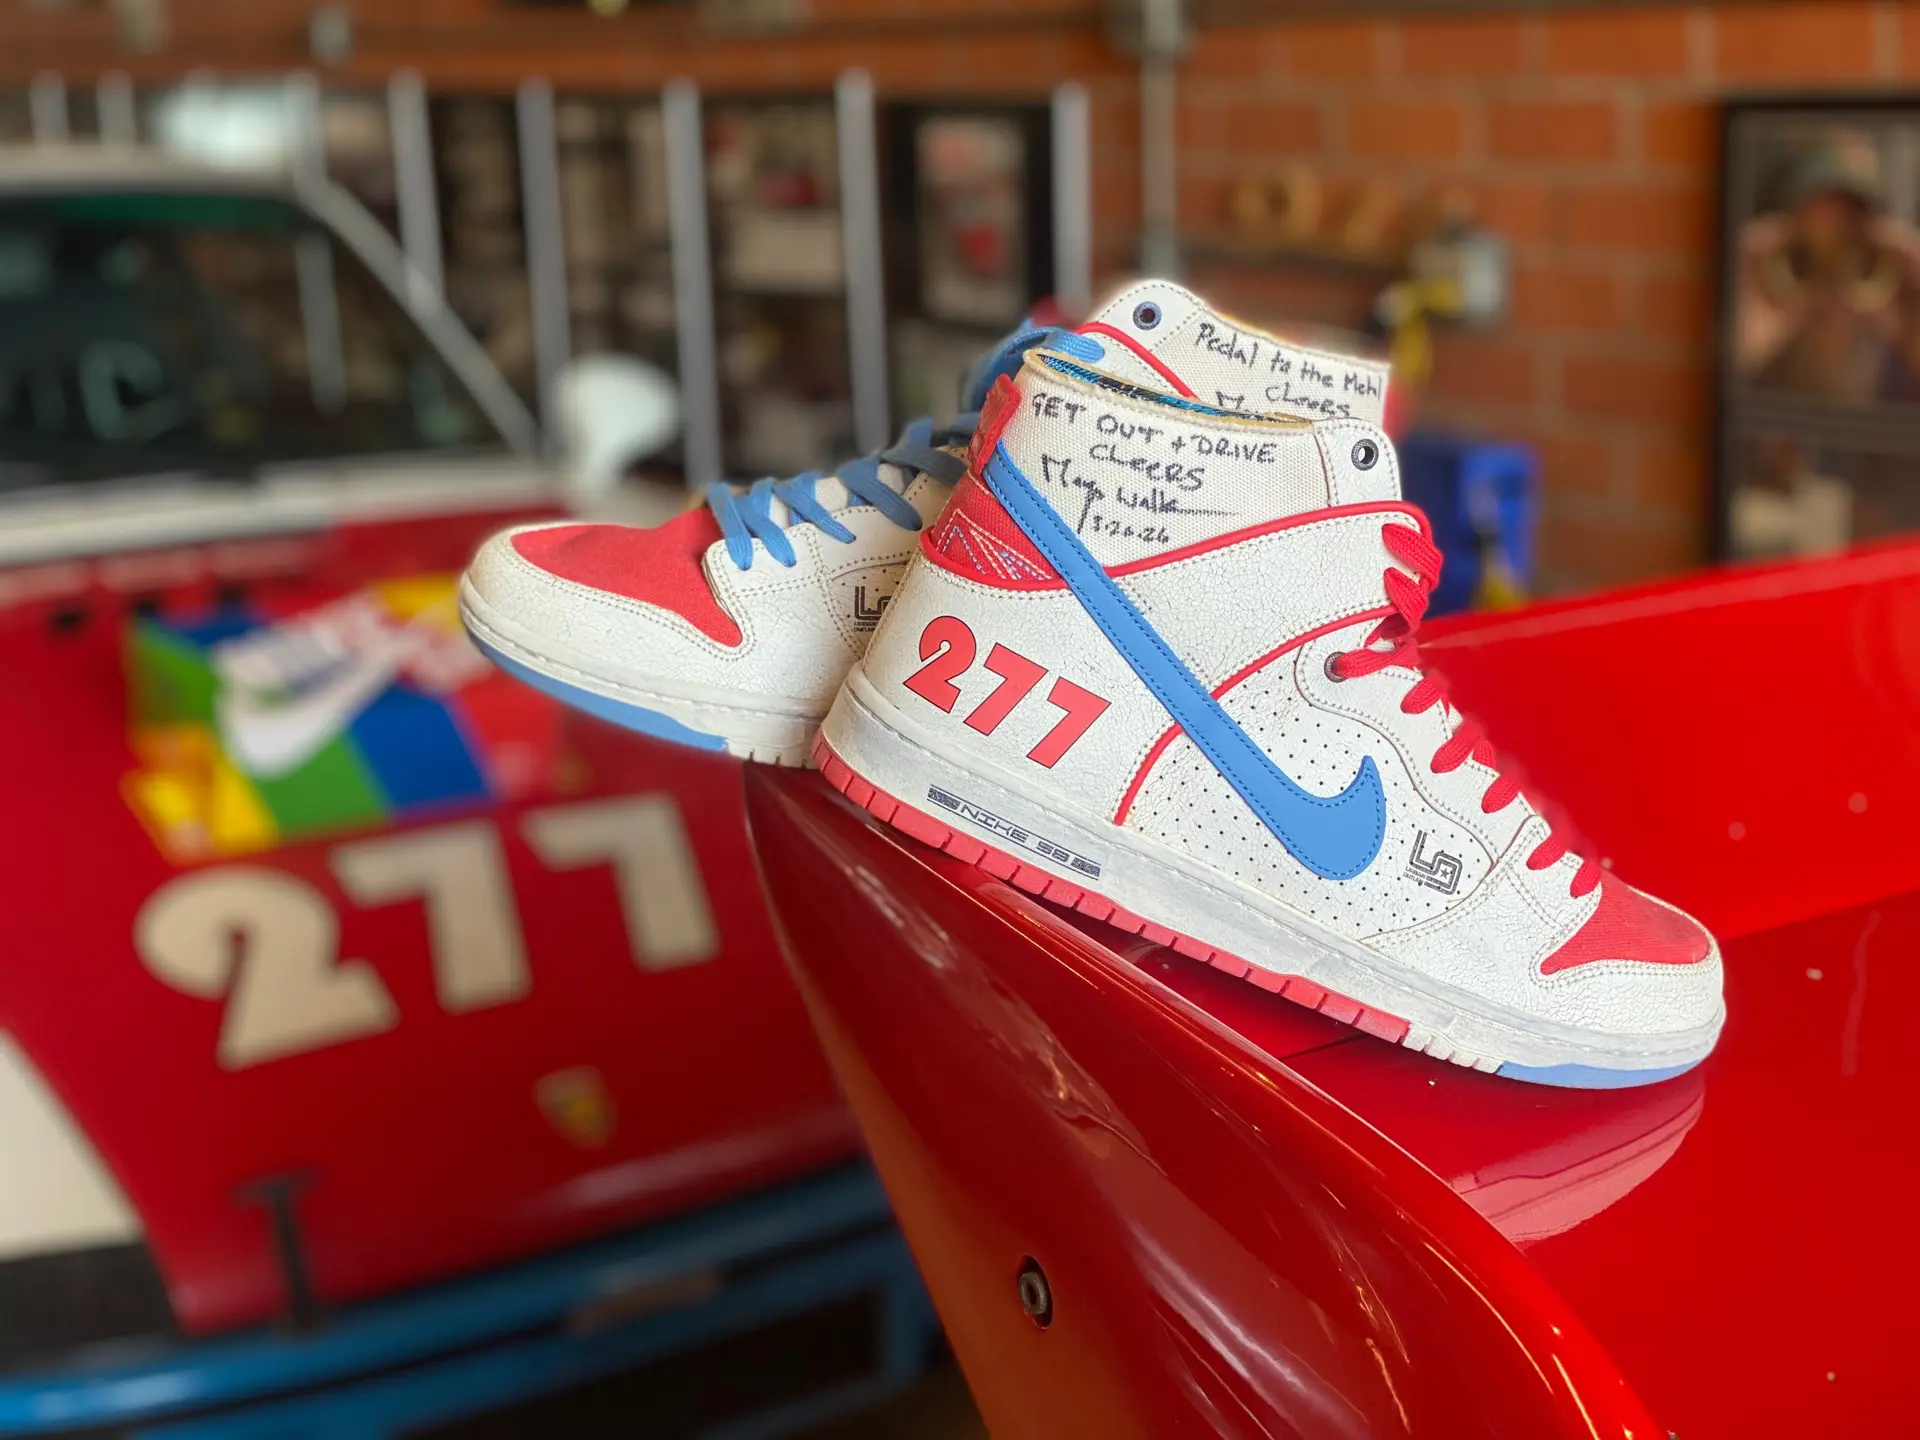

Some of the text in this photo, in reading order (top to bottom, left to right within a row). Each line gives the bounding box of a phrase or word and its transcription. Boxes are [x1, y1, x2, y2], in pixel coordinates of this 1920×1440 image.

[1195, 322, 1259, 368] Pedal
[1270, 349, 1292, 374] to
[1300, 360, 1333, 388] the
[1032, 392, 1087, 424] GET
[1096, 413, 1165, 444] OUT
[1191, 433, 1278, 464] DRIVE
[902, 615, 1112, 770] 277
[960, 803, 1030, 843] NIKE
[132, 790, 721, 1073] 277
